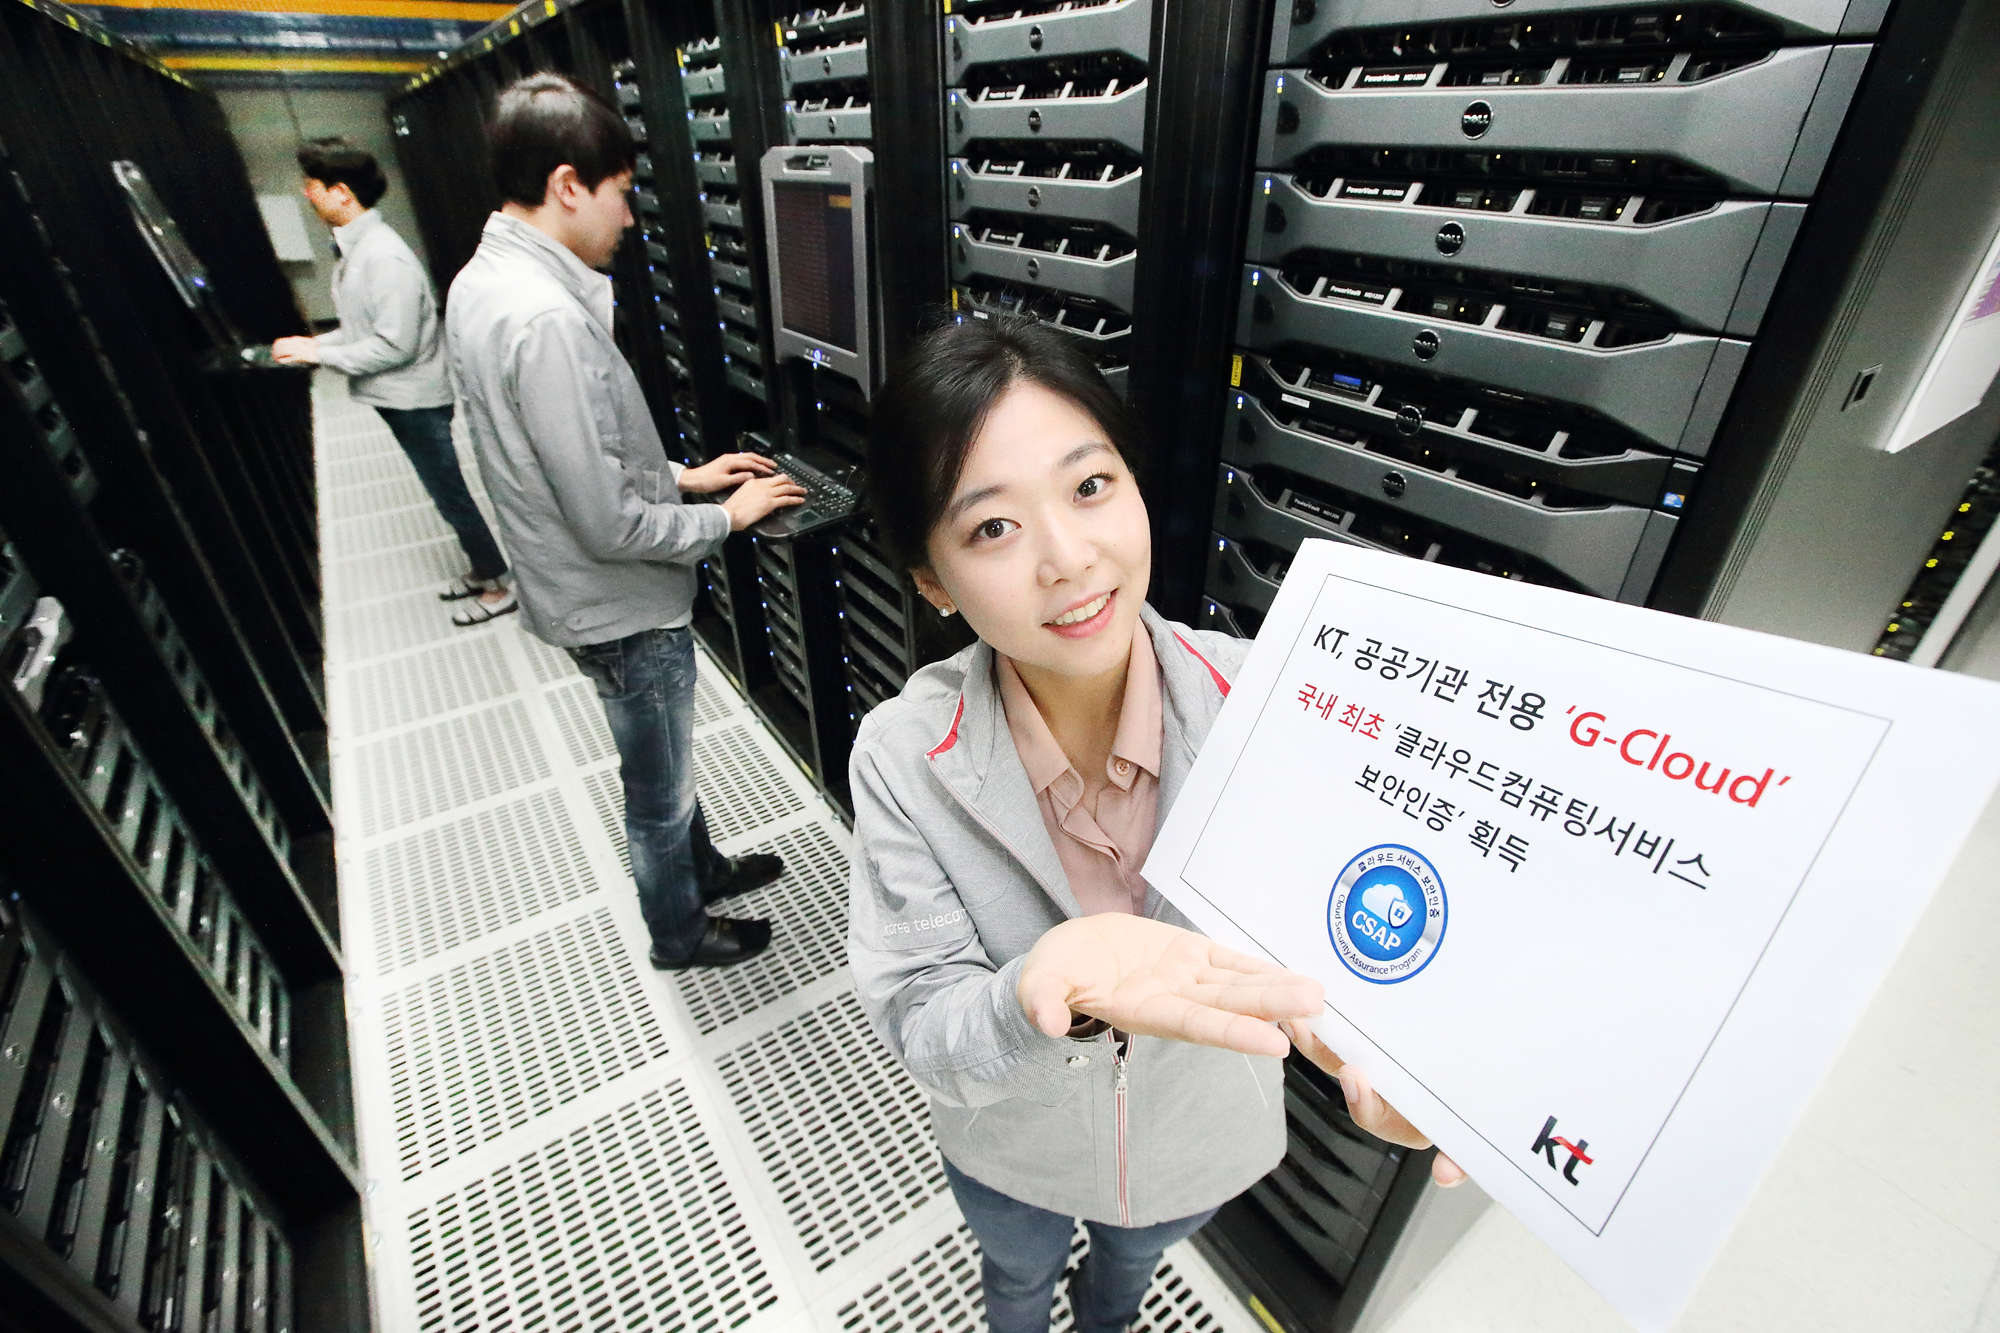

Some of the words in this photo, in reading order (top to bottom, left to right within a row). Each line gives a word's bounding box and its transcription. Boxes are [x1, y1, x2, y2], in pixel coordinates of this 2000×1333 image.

[1313, 624, 1350, 660] KT,
[1354, 637, 1469, 704] 공공기관
[1476, 679, 1546, 732] 전용
[1297, 683, 1338, 721] 국내
[1337, 703, 1386, 742] 최초
[1468, 819, 1530, 874] 획득
[1334, 894, 1346, 919] Cloud
[1358, 852, 1394, 873] 클라우드
[1397, 854, 1422, 876] 서비스
[1421, 875, 1440, 919] 보안인증
[1335, 921, 1352, 957] Security
[1351, 910, 1402, 951] CSAP
[1349, 953, 1389, 975] Assurance
[1390, 947, 1423, 973] Program
[1531, 1115, 1594, 1187] kt
